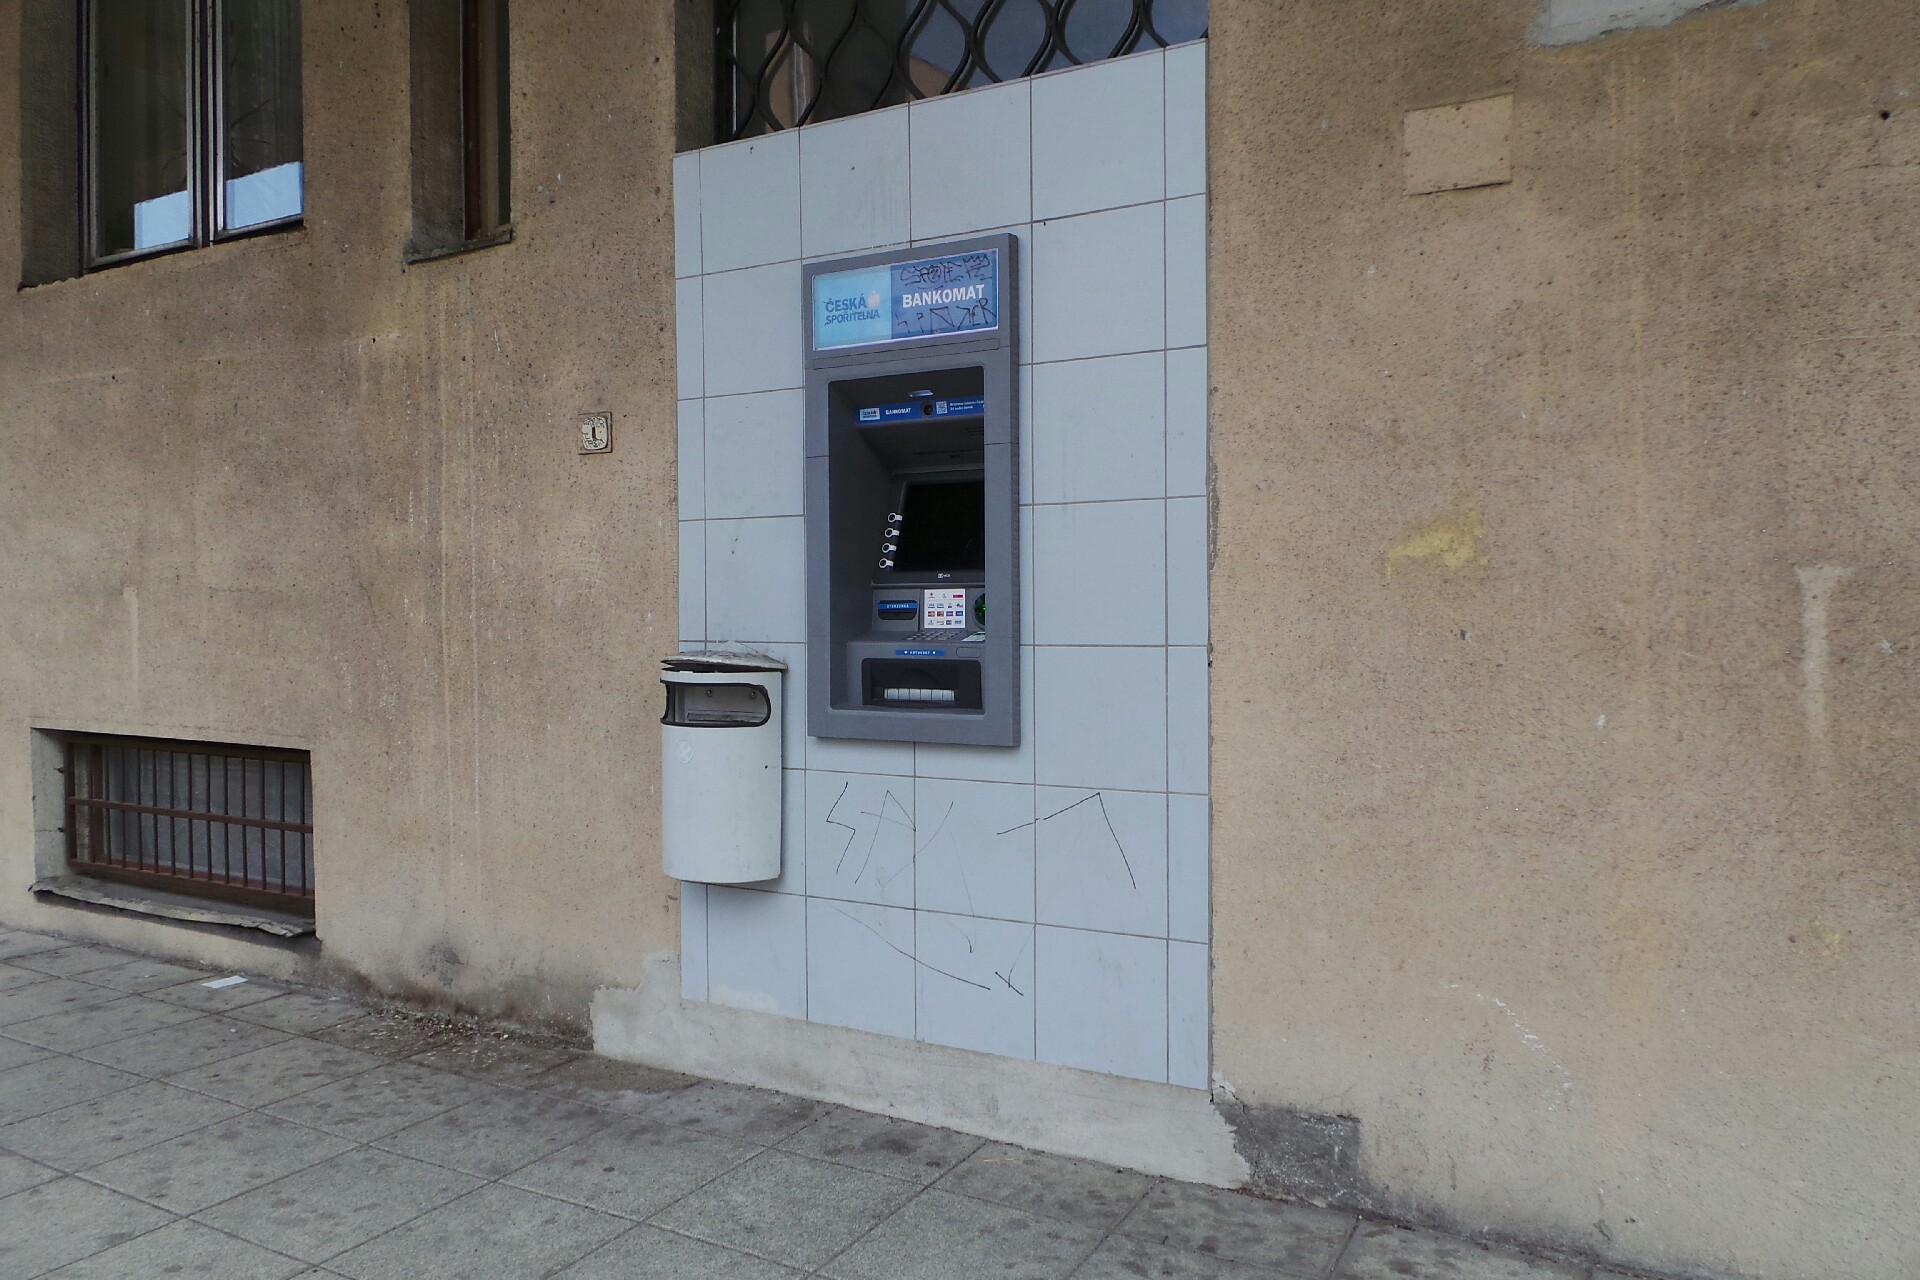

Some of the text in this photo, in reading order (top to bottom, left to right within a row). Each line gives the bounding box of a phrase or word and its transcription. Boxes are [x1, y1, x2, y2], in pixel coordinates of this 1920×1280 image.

[825, 293, 867, 312] ČESKÁ
[902, 284, 985, 308] BANKOMAT
[825, 309, 881, 325] SPOŘITELNA
[885, 407, 912, 416] BANKOMAT
